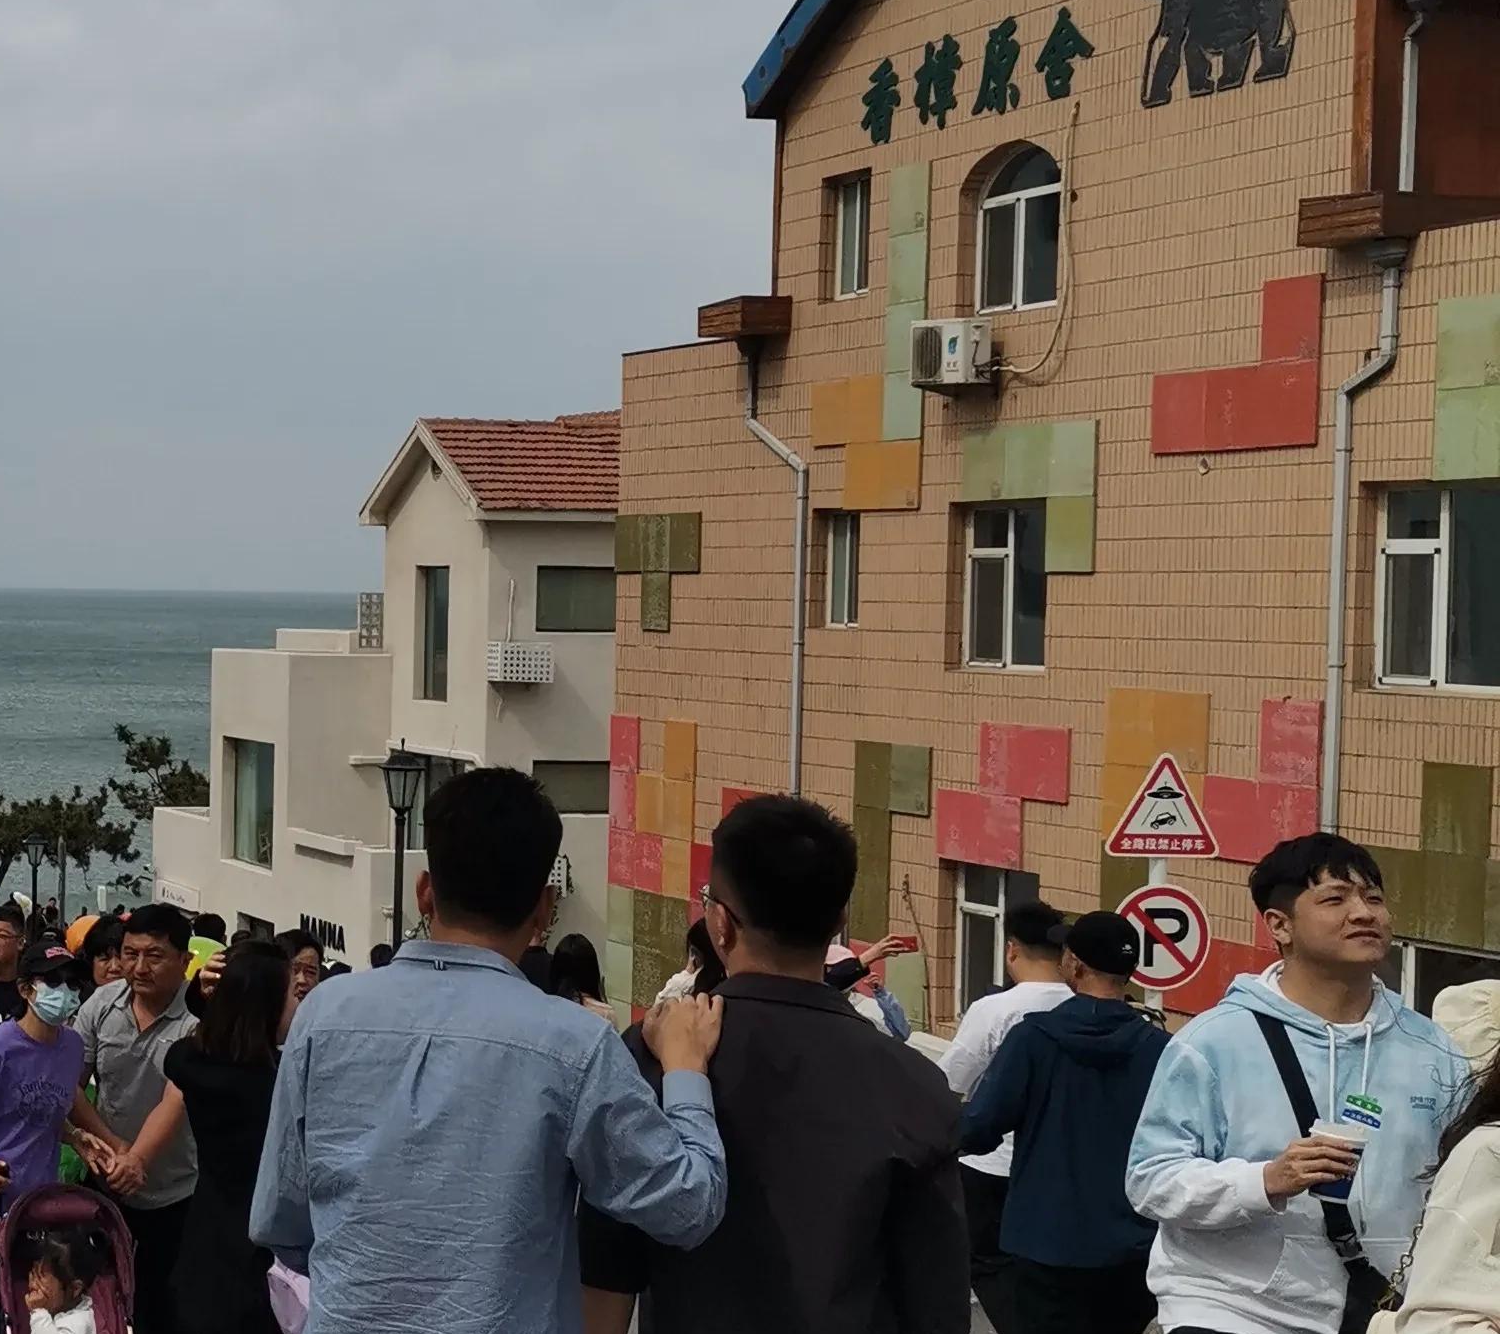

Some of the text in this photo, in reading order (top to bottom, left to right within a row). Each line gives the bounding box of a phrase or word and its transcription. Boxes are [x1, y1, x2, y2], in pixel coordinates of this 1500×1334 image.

[1120, 837, 1205, 851] 全路段禁止停车
